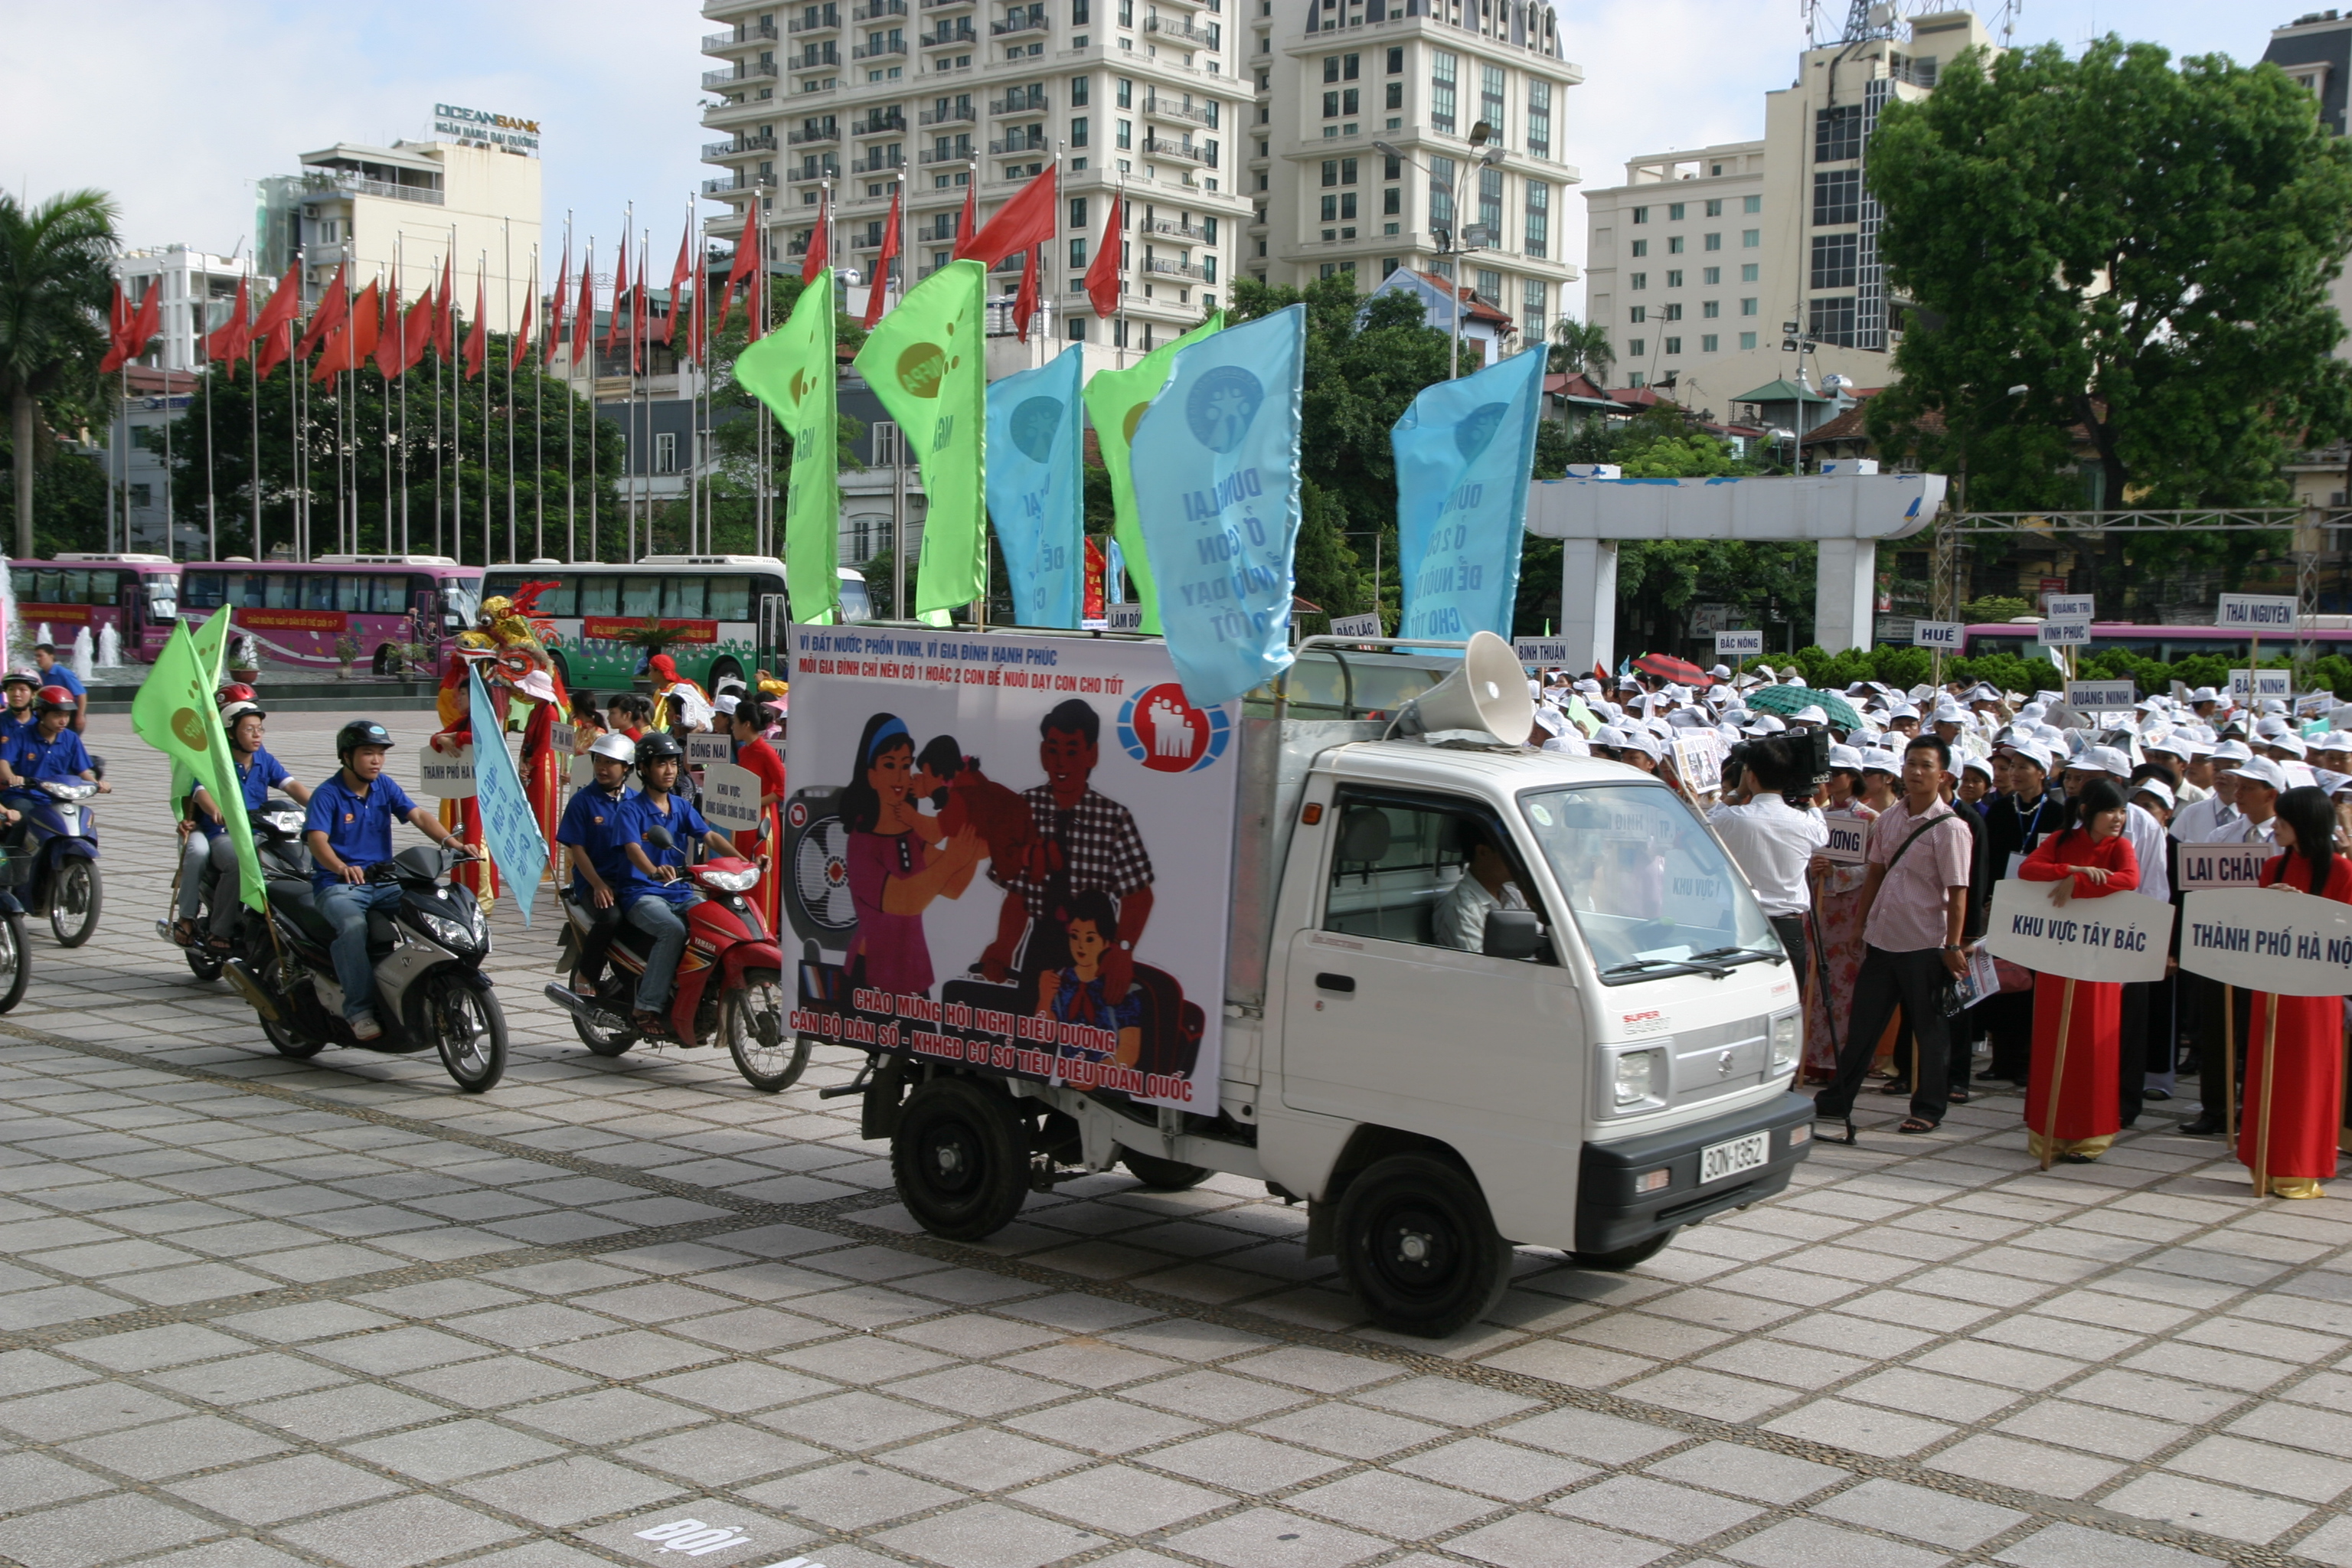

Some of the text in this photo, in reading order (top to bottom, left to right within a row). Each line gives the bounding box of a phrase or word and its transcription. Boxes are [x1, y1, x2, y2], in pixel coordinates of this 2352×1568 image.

[435, 103, 541, 134] OCEANBANK
[1111, 608, 1142, 628] LÂM ĐỒ
[2053, 599, 2090, 615] QUẢNG TRỊ
[2226, 600, 2292, 623] THÁI NGUYÊN
[1720, 635, 1758, 648] ĐẮC NÔNG
[1922, 626, 1956, 642] HUẾ
[2044, 623, 2084, 640] VĨNH PHÚC
[800, 632, 809, 650] VÌ
[812, 632, 831, 652] ĐẤT
[834, 633, 862, 653] NƯỚC
[897, 640, 924, 658] VINH,
[927, 639, 937, 658] VÌ
[940, 642, 958, 659] GIA
[961, 642, 988, 662] ĐÌNH
[1026, 646, 1057, 666] PHÚC
[1519, 642, 1566, 664] BÌNH THUẬN
[799, 653, 816, 673] MỖI
[818, 659, 835, 675] GIA
[837, 657, 859, 675] ĐÌNH
[862, 657, 877, 677] CHỈ
[880, 660, 900, 679] NÊN
[903, 662, 915, 680] CÓ
[918, 666, 923, 680] 1
[926, 664, 952, 685] HOẶC
[954, 668, 961, 683] 2
[964, 668, 985, 685] CON
[1004, 669, 1028, 688] NUÔI
[1032, 673, 1052, 692] DẠY
[1055, 675, 1076, 692] CON
[1080, 676, 1101, 693] CHO
[1105, 673, 1124, 695] TỐT
[2073, 685, 2128, 706] QUẢNG NINH
[2260, 679, 2285, 694] NINH
[713, 744, 727, 758] NAI
[423, 763, 445, 779] THÀNH
[446, 760, 459, 779] PHỐ
[461, 763, 470, 779] HÀ
[1825, 828, 1860, 851] ƯƠNG
[2187, 852, 2265, 881] LAI CHÂU
[1673, 877, 1692, 896] KHU
[1695, 878, 1714, 900] VỰC
[2012, 914, 2147, 952] KHU VỰC TÂY BẮC
[2192, 920, 2352, 969] THÀNH PHỐ HÀ NỘ
[853, 987, 1116, 1054] CHÀO MỪNG HỘI NGHỊ BIỂU DƯƠNG
[1622, 1011, 1660, 1023] SUPER
[789, 1007, 819, 1034] CÁN
[822, 1012, 841, 1042] BỘ
[844, 1016, 875, 1044] DÂN
[878, 1020, 902, 1047] SỐ
[912, 1030, 964, 1060] KHHGĐ
[967, 1040, 990, 1065] CƠ
[991, 1038, 1015, 1069] SỞ
[1018, 1047, 1054, 1076] TIÊU
[1057, 1051, 1095, 1084] BIỂU
[1098, 1063, 1143, 1095] TOÀN
[1146, 1070, 1193, 1102] QUỐC
[1704, 1137, 1762, 1178] 30N-1352
